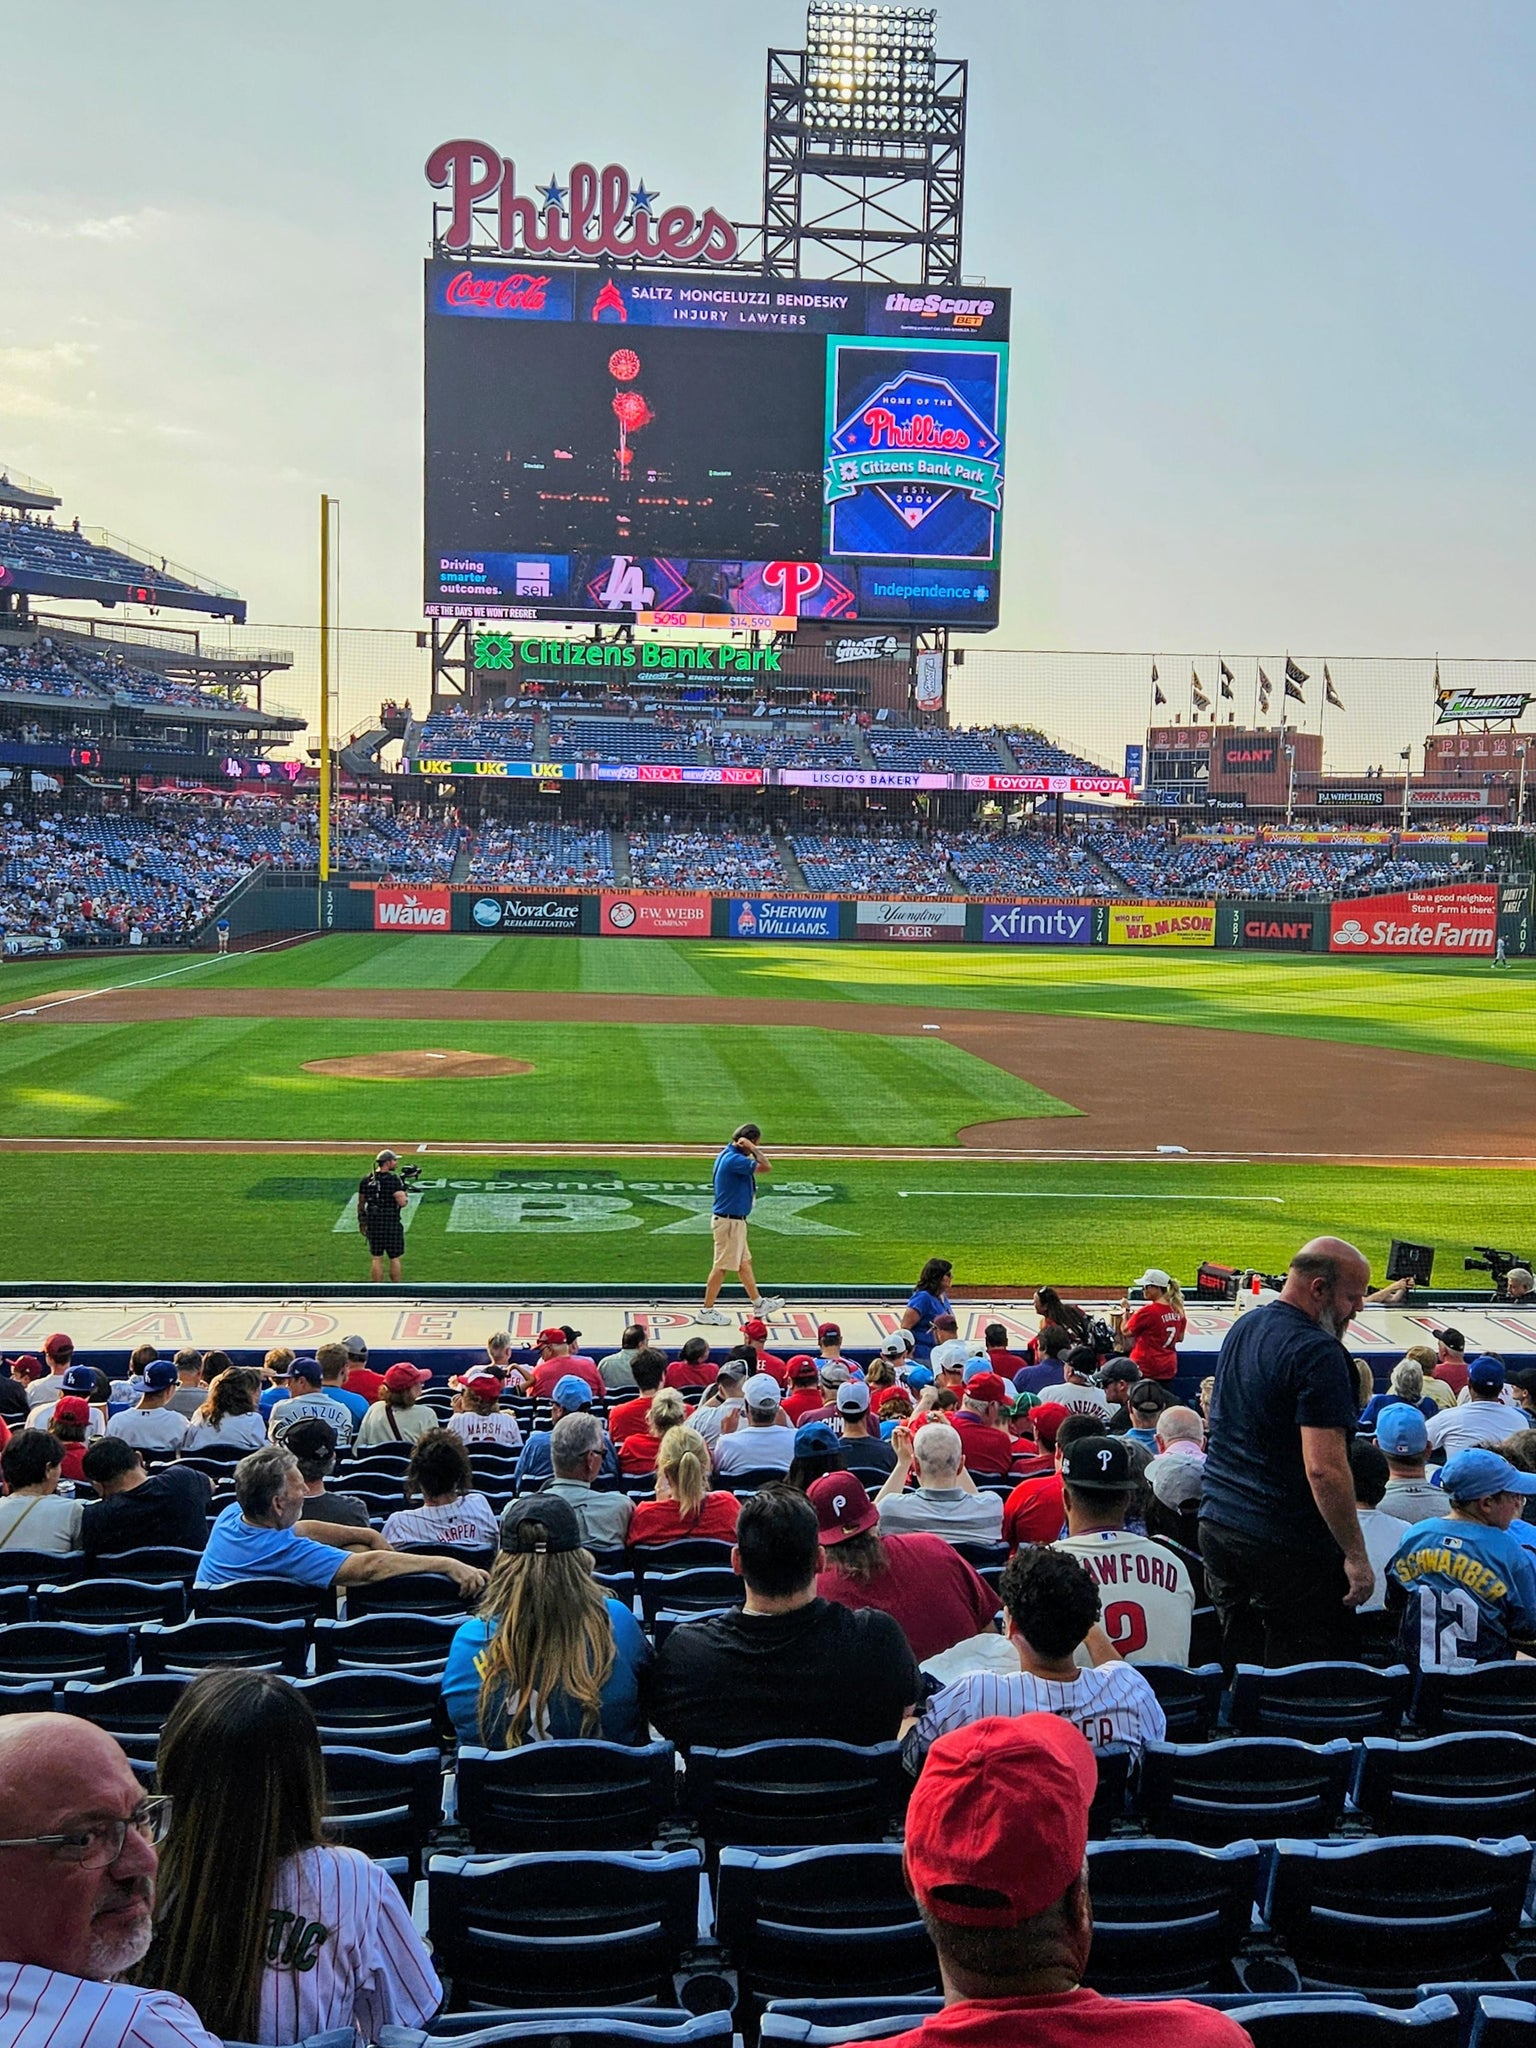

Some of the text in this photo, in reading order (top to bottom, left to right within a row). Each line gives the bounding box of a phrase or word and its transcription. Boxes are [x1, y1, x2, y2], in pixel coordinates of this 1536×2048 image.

[424, 138, 739, 263] Phillies
[631, 287, 849, 309] SALTZ MONGELUZZI BENDESKY
[885, 293, 995, 316] theScore
[673, 309, 807, 325] INJURY LAWYERS
[956, 317, 981, 325] BET
[882, 397, 953, 407] HOME OF THE
[863, 407, 971, 450] Phillies
[860, 460, 986, 482] Citizens Bank Park
[896, 495, 932, 504] 2004
[440, 559, 485, 573] Driving
[440, 573, 487, 582] smarter
[440, 584, 502, 595] outcomes.
[763, 561, 823, 618] P
[873, 583, 971, 599] Independence
[425, 605, 440, 615] ARE
[441, 606, 454, 616] THE
[455, 607, 473, 617] DAYS
[474, 607, 486, 617] WE
[486, 608, 509, 618] WON'T
[519, 638, 782, 671] Citizens Bank Park
[1226, 750, 1273, 763] GIANT
[419, 760, 452, 774] UKG
[475, 762, 508, 775] UKG
[531, 763, 563, 777] UKG
[640, 768, 678, 780] NECA
[725, 770, 762, 782] NECA
[813, 773, 920, 786] LISCIO'S BAKERY
[993, 777, 1045, 789] TOYOTA
[1075, 778, 1126, 790] TOYOTA
[1216, 800, 1244, 809] Fanatics
[377, 883, 433, 891] ASPLUNDH
[444, 884, 499, 892] ASPLUNDH
[642, 889, 696, 897] ASPLUNDH
[1408, 892, 1425, 901] Like
[1434, 893, 1454, 903] good
[1456, 894, 1495, 904] neighbor,
[379, 903, 447, 925] Wawa
[503, 901, 580, 917] NovaCare
[665, 908, 704, 919] WEBB
[759, 903, 827, 919] SHERWIN
[877, 903, 946, 923] Yuengling
[1412, 905, 1434, 913] State
[1437, 905, 1459, 913] Farm
[1460, 905, 1468, 914] is
[503, 920, 577, 928] REHABILITATION
[653, 919, 688, 927] COMPANY
[989, 907, 1085, 938] xfinity
[888, 926, 933, 937] LAGER
[1245, 920, 1313, 939] GIANT
[332, 1192, 860, 1235] IBX
[1163, 1326, 1176, 1348] 7
[467, 1422, 501, 1435] MARSH
[1097, 1449, 1113, 1472] P
[832, 1494, 847, 1517] P
[1395, 1547, 1509, 1600] SCHWARBER
[1419, 1584, 1479, 1670] 12
